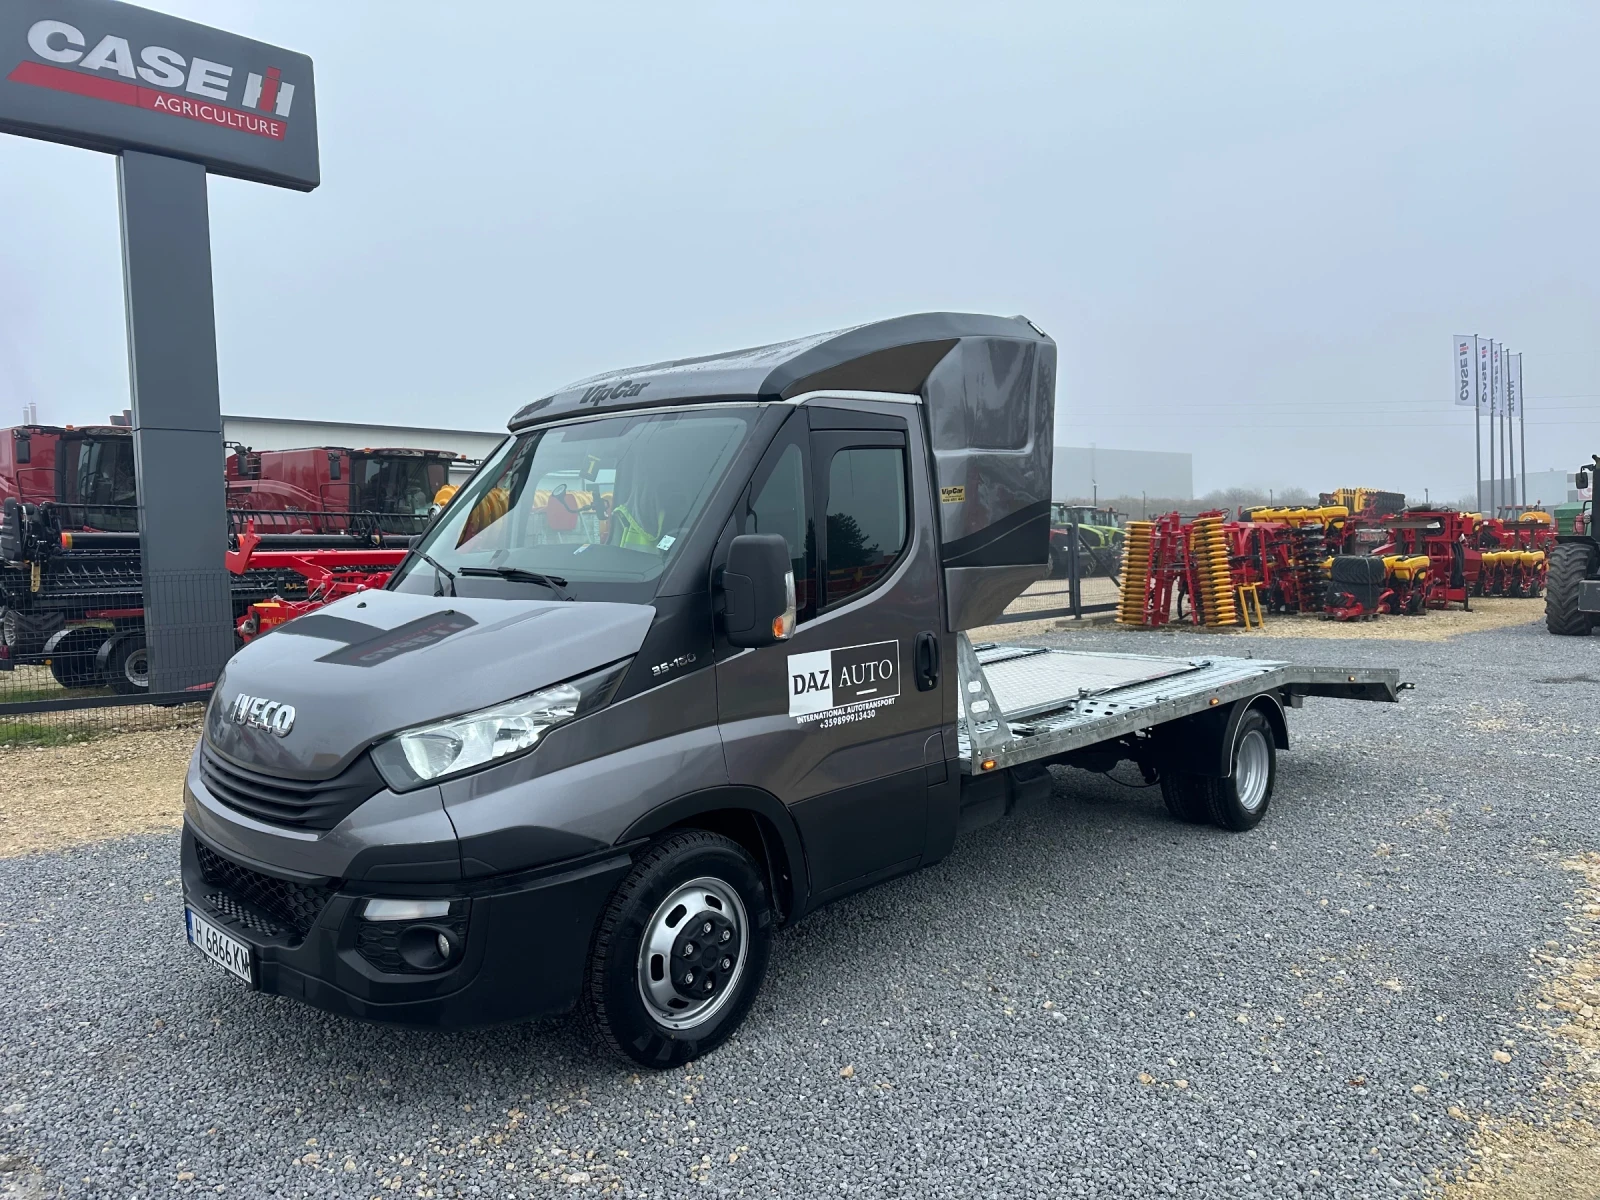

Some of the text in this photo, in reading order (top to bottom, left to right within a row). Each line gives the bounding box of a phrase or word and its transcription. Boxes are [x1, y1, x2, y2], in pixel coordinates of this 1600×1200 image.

[27, 19, 233, 101] CASE
[154, 95, 279, 137] AGRICULTURE
[579, 380, 651, 406] VipCar
[941, 487, 964, 496] VipCar
[792, 659, 893, 695] DAZ AUTO
[231, 692, 296, 738] IVECO
[796, 698, 895, 724] INTERNATIONAL AUTOTRANSPORT
[819, 709, 876, 729] +359899913430
